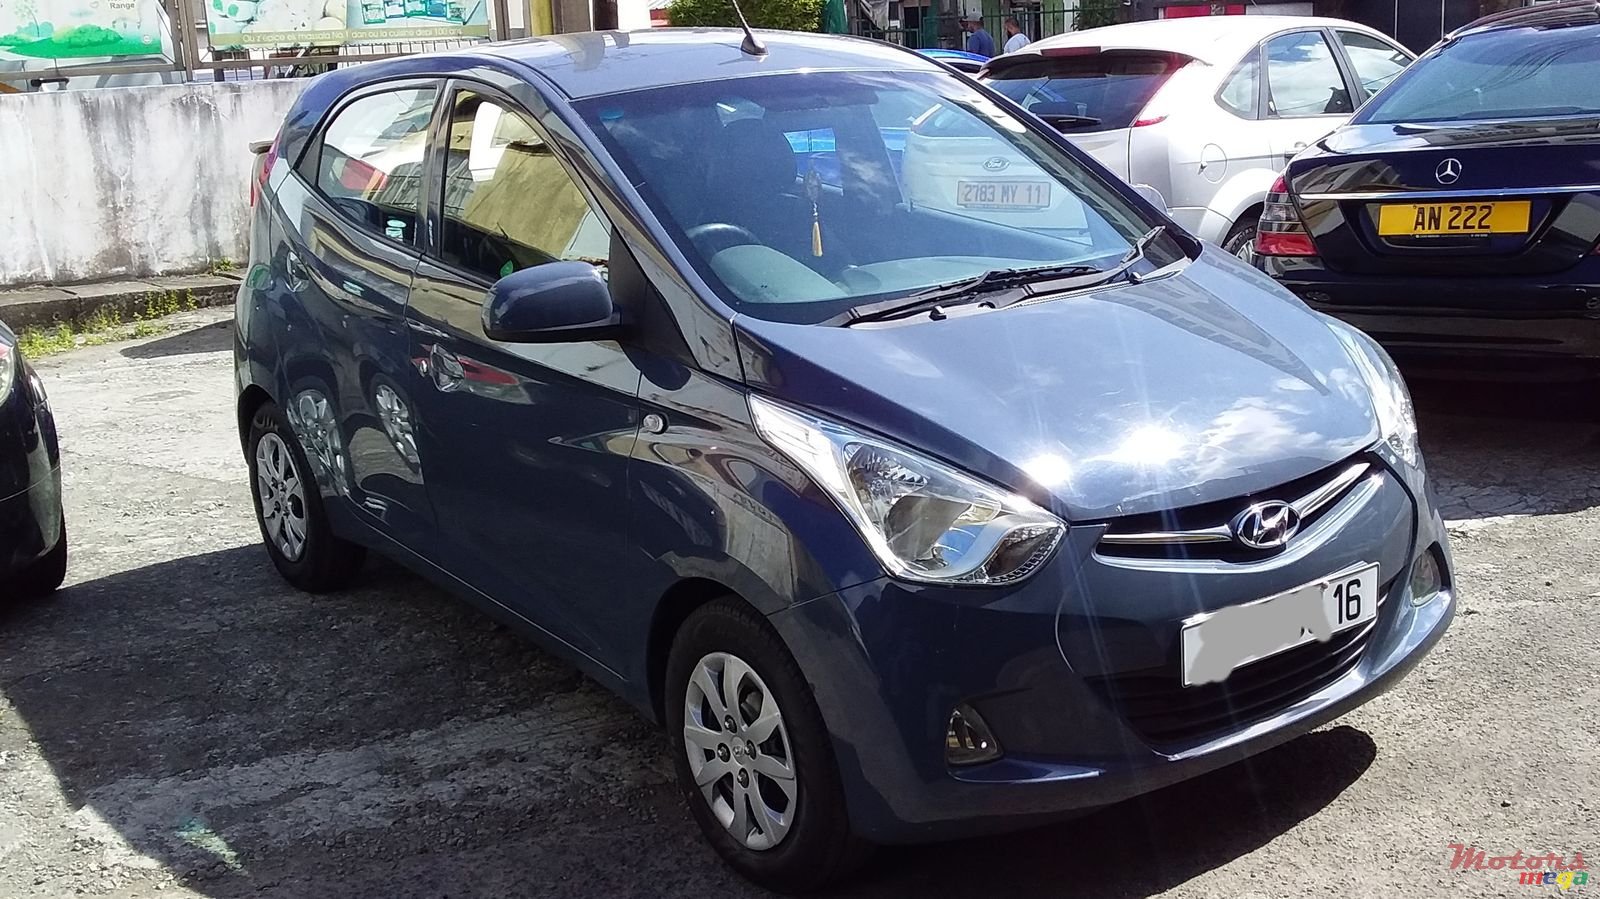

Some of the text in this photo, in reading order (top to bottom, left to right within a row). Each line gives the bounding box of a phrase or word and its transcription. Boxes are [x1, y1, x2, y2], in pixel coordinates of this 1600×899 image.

[964, 184, 1041, 204] 2783 MY 11
[1414, 205, 1492, 231] AN 222
[1333, 578, 1362, 625] 16
